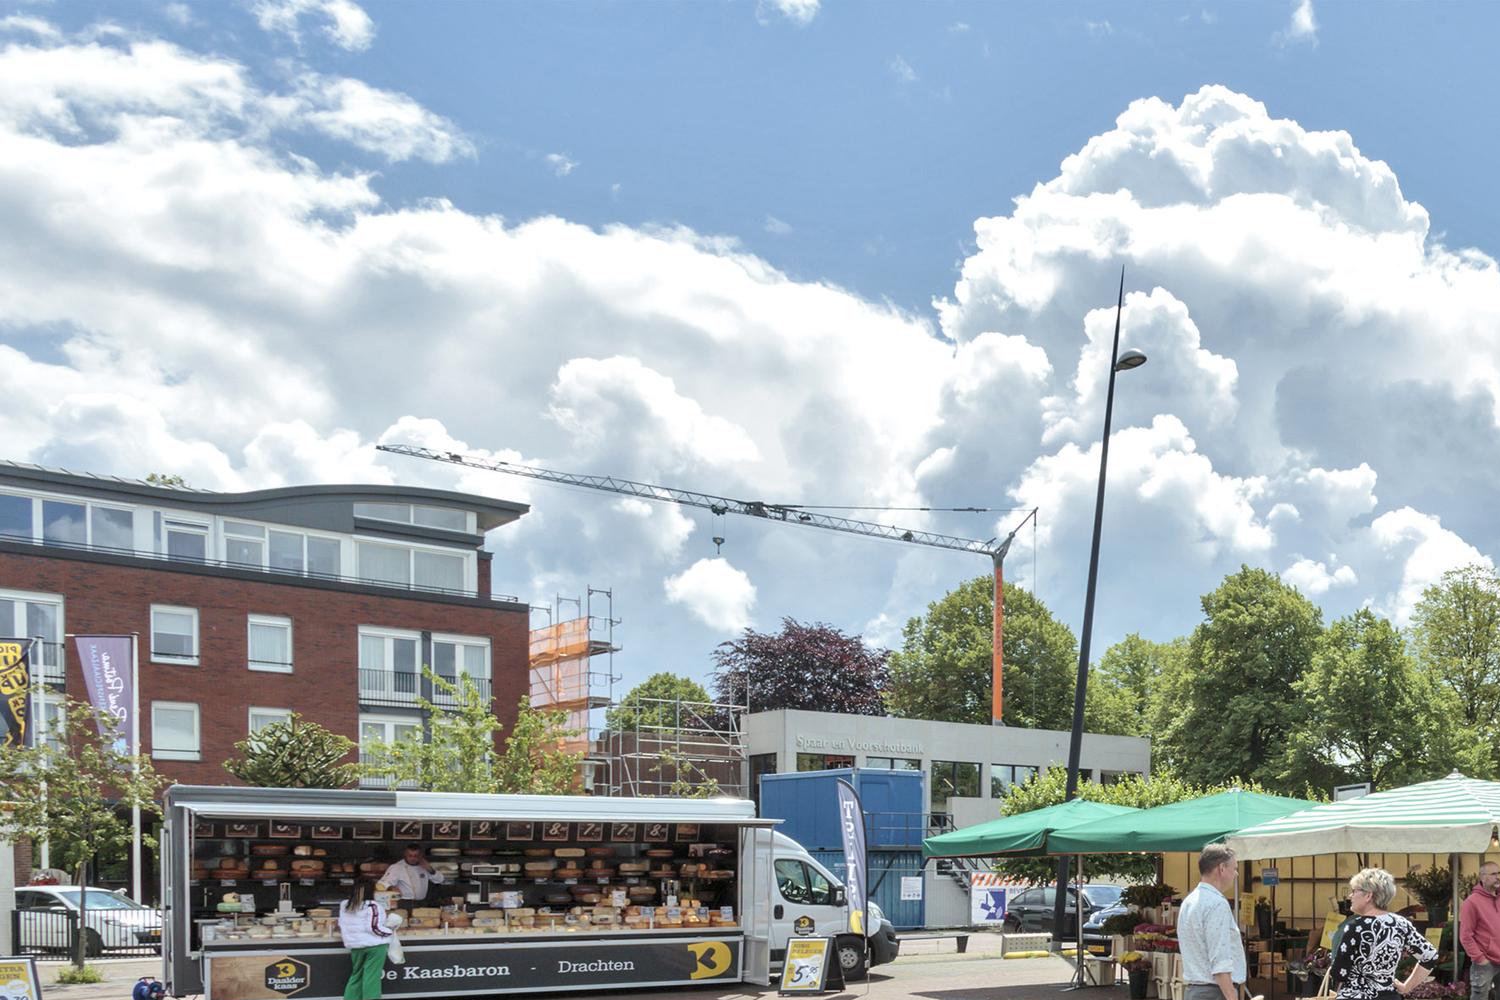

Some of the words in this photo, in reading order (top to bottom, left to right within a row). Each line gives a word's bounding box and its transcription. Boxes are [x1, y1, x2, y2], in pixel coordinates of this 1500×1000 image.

[832, 741, 846, 750] en
[847, 738, 924, 755] Voorschotbank
[403, 965, 511, 980] Kaasbaron
[558, 960, 635, 974] Drachten
[268, 976, 305, 985] Daalder
